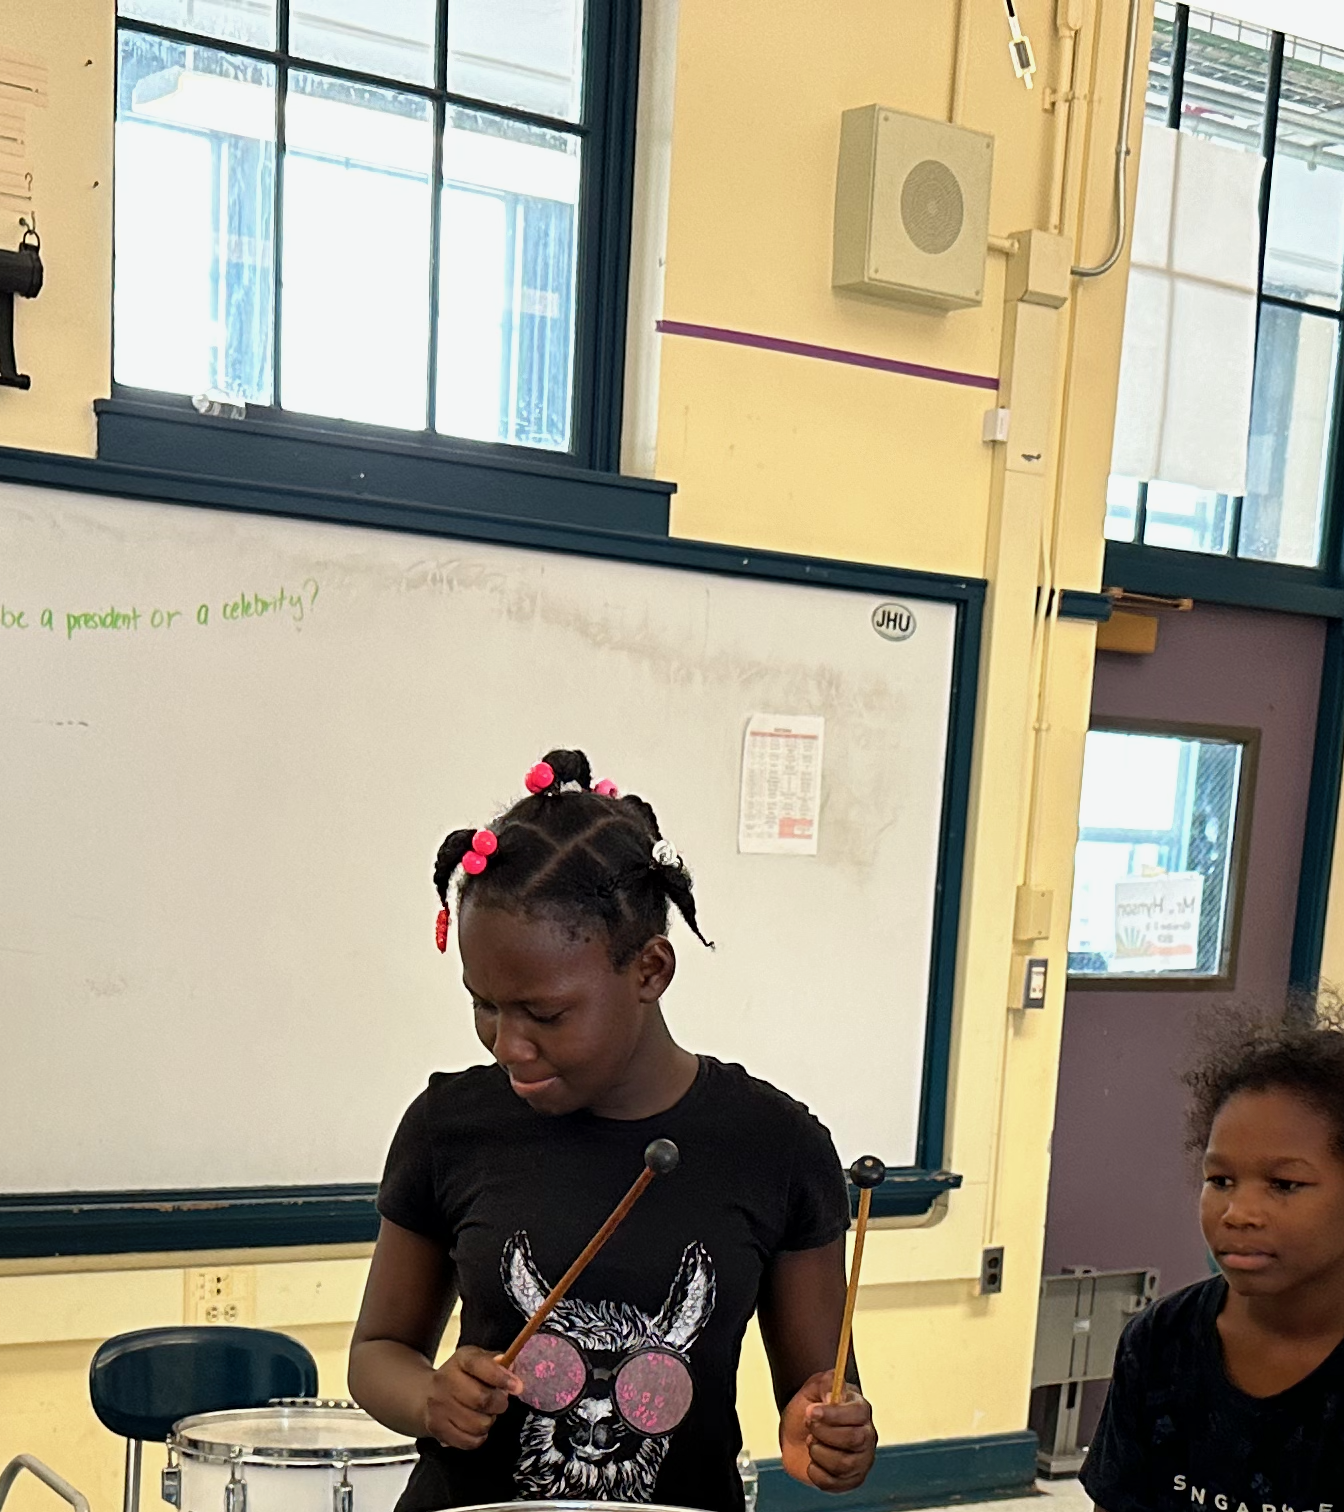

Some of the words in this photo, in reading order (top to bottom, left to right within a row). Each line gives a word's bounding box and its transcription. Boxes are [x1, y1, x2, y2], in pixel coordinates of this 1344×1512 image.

[1, 602, 29, 629] be
[40, 608, 54, 631] a
[66, 605, 142, 640] president
[150, 608, 183, 630] or
[197, 602, 210, 626] a
[222, 577, 320, 625] celebrity?
[875, 610, 911, 632] JHU
